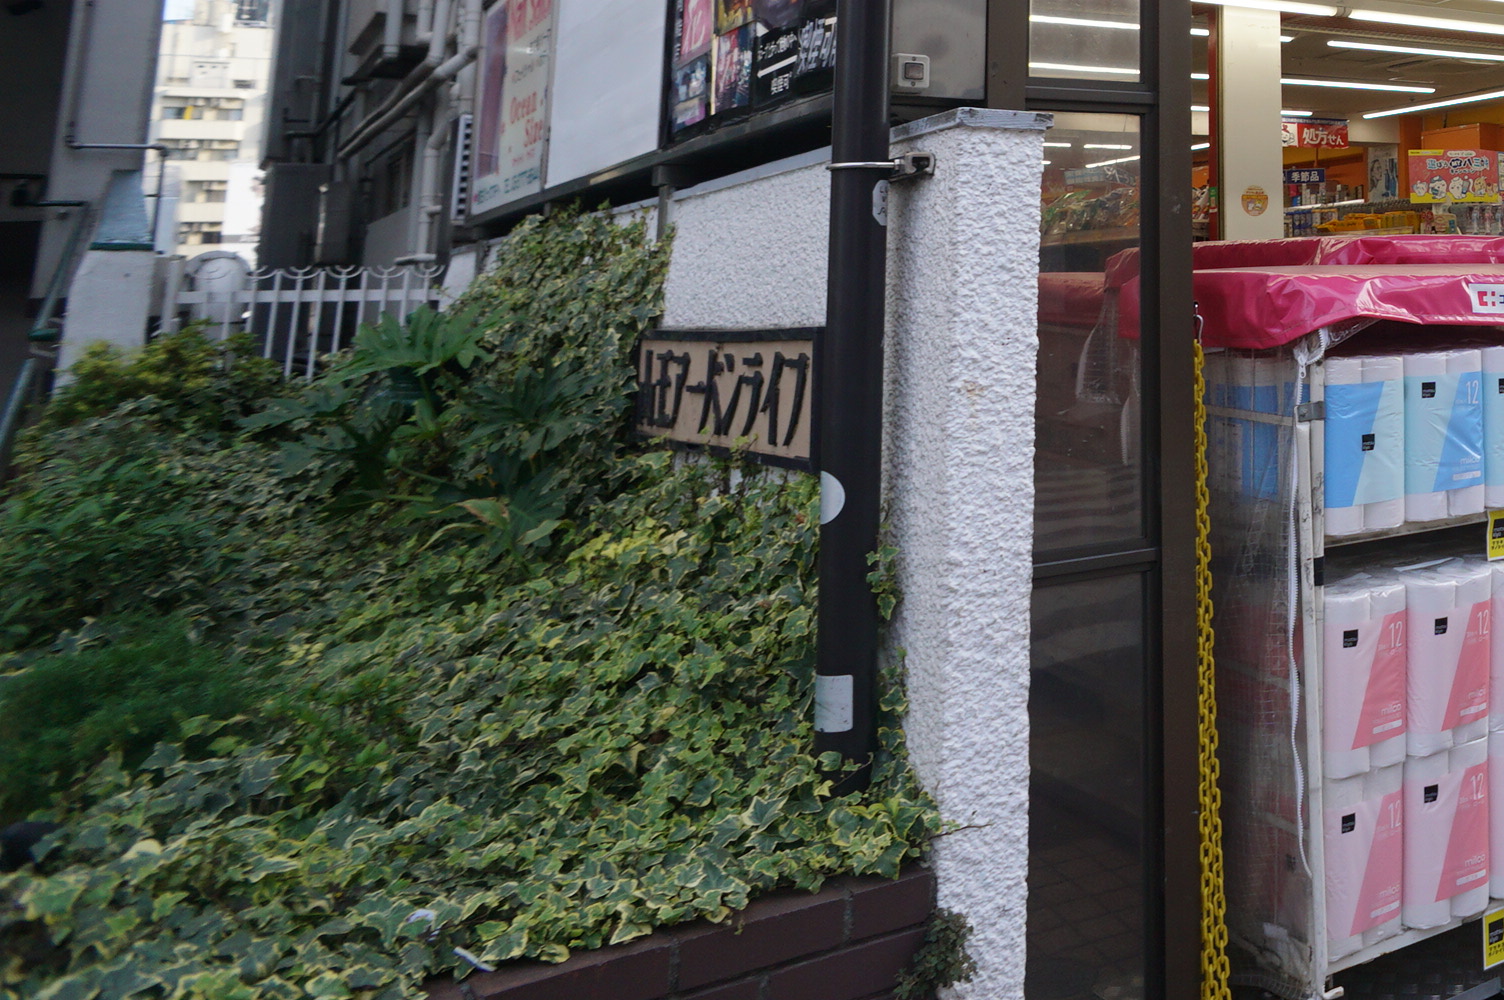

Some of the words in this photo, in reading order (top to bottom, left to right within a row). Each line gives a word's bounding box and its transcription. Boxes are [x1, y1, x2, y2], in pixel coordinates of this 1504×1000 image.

[1302, 127, 1345, 146] 処方せん
[1291, 170, 1320, 182] 季節品
[1466, 380, 1479, 405] 12
[1388, 620, 1403, 648] 12
[1477, 609, 1489, 636] 12
